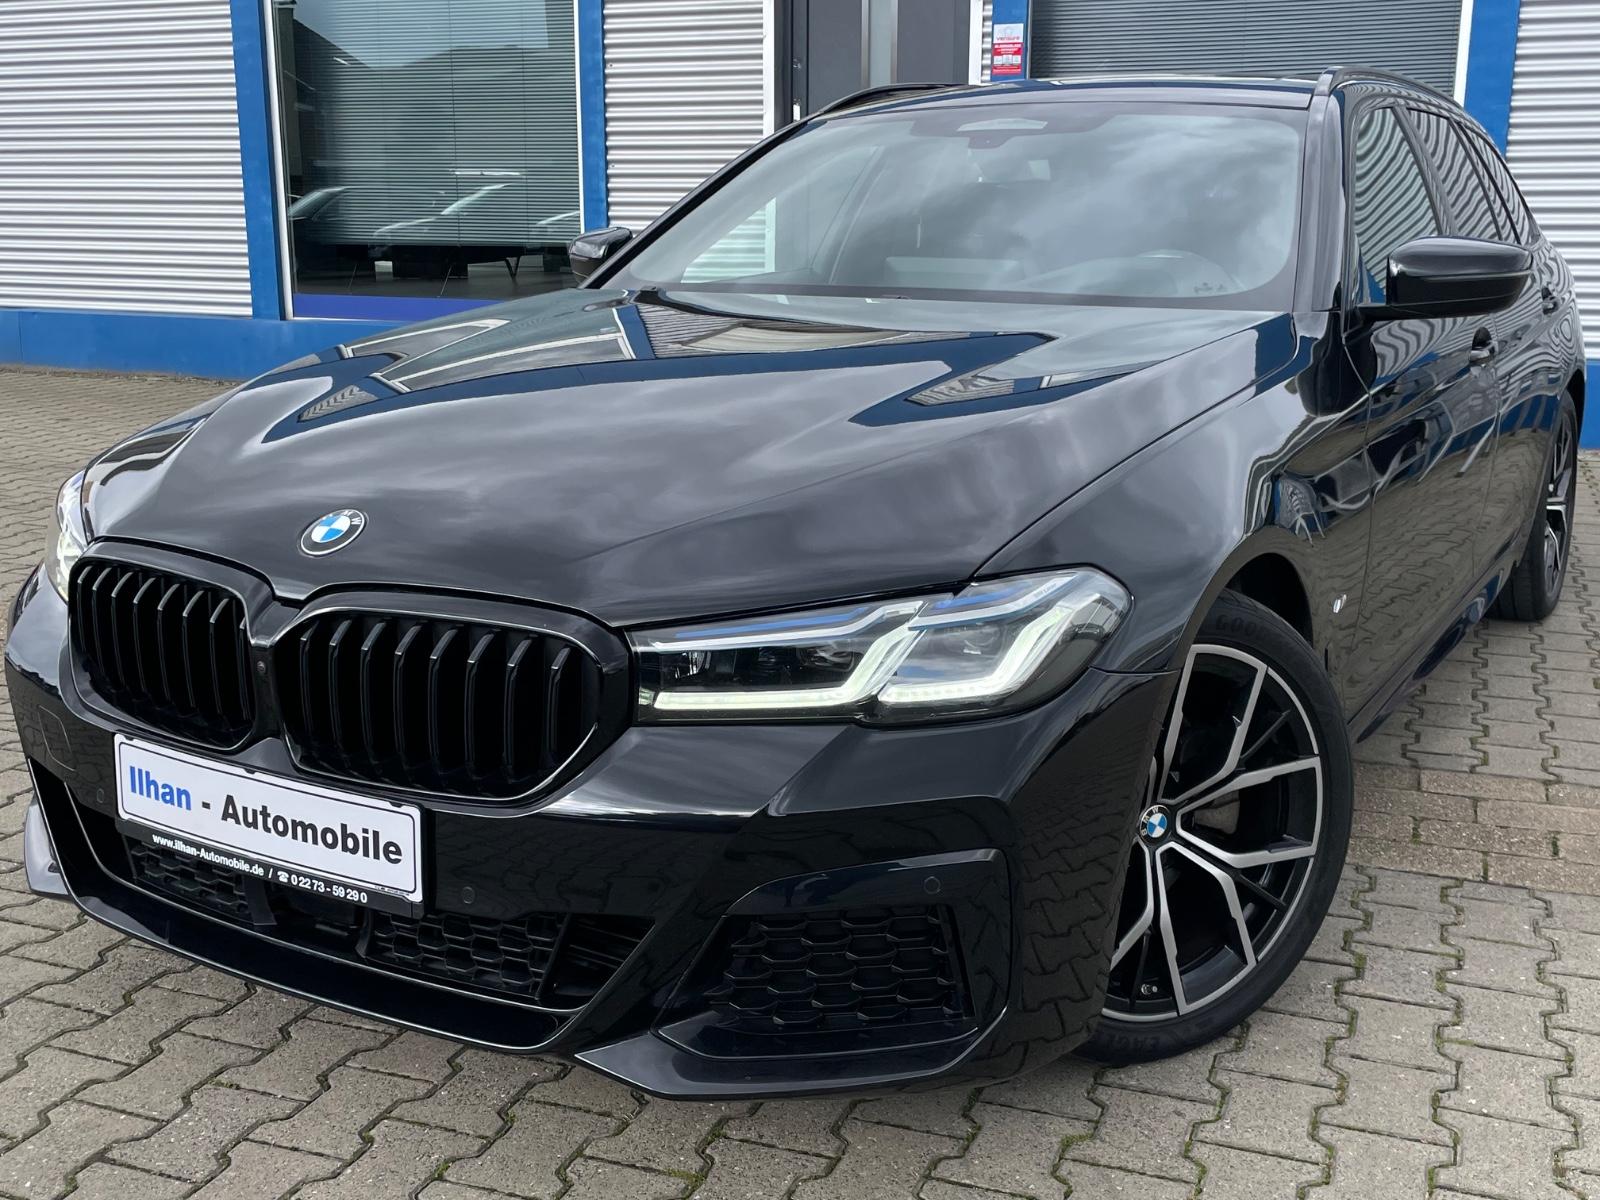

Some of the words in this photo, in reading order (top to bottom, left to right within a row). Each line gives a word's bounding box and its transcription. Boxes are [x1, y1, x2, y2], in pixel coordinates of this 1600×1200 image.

[129, 766, 192, 810] Ilhan
[221, 794, 403, 865] Automobile
[1141, 806, 1159, 837] BMW
[152, 834, 265, 876] www.ilhan-Automobile.de
